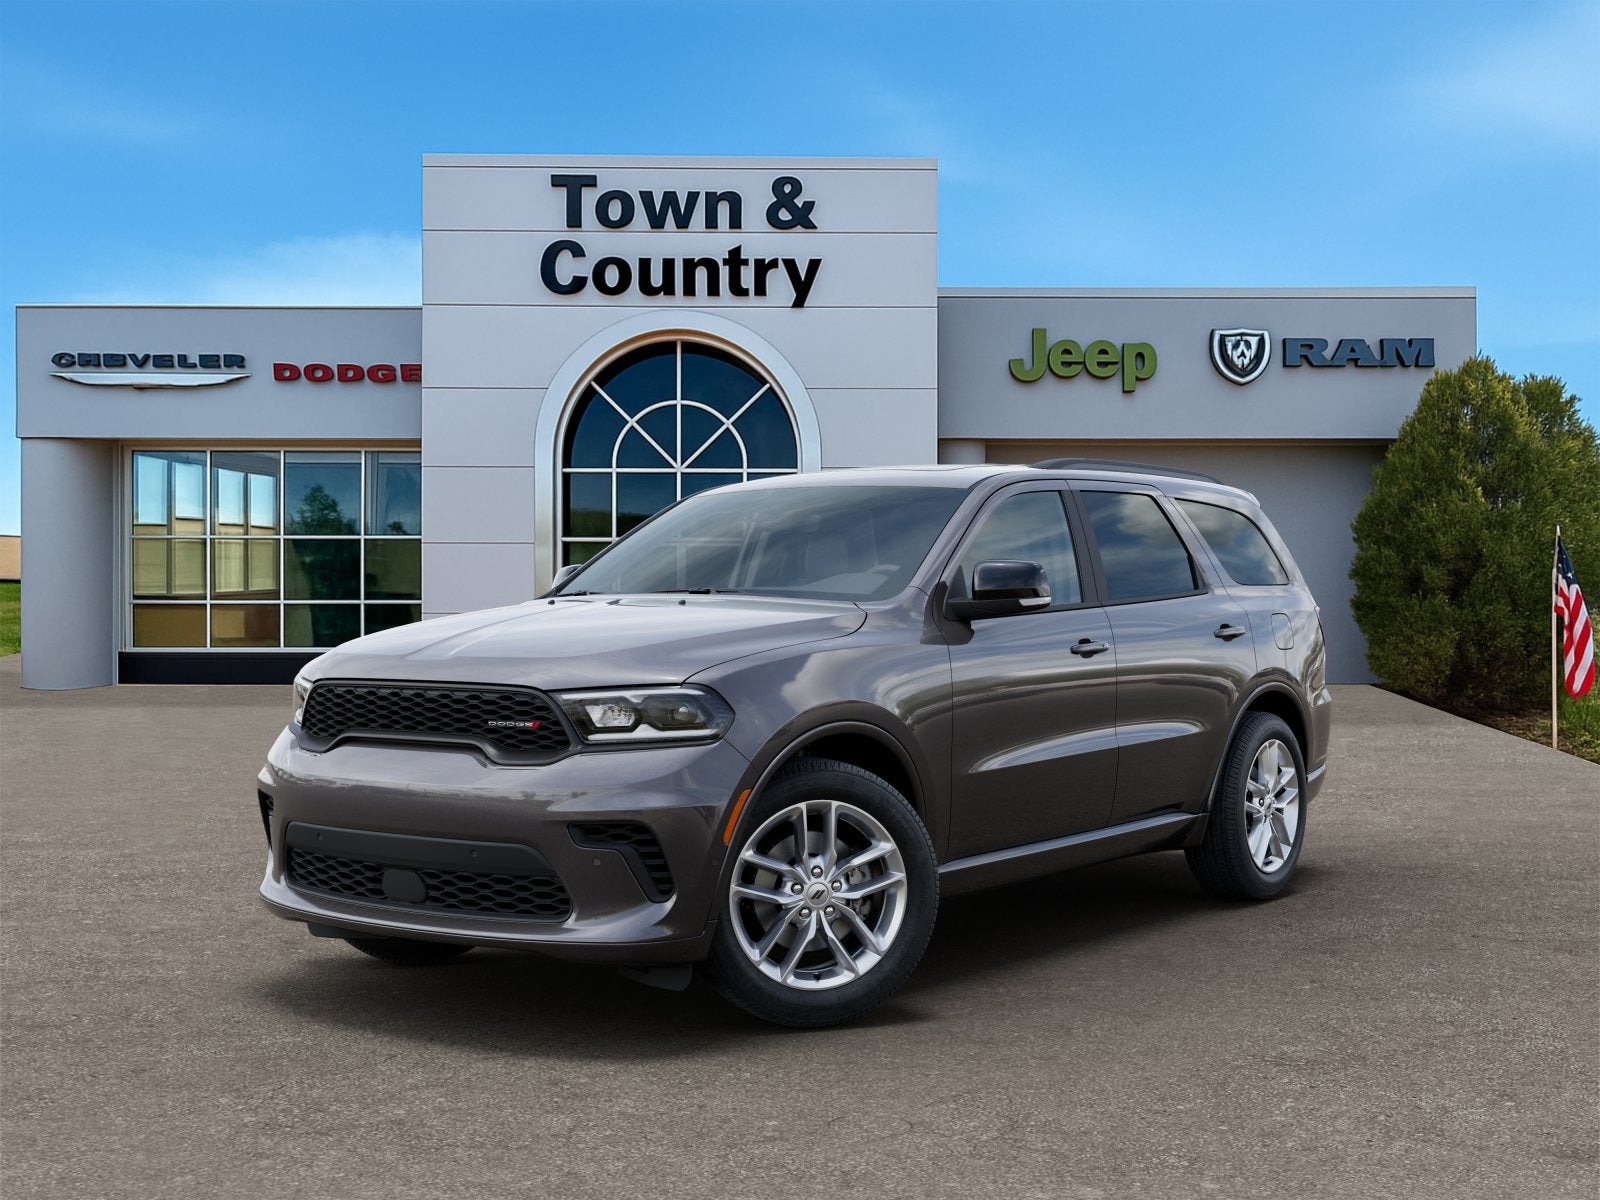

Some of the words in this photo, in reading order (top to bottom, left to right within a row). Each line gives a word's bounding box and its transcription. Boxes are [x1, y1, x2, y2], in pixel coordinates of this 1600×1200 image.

[550, 174, 742, 230] Town
[765, 175, 818, 230] &
[540, 239, 822, 308] Country
[272, 362, 422, 383] DODGE
[1009, 327, 1158, 393] Jeep
[1282, 337, 1436, 368] RAM
[487, 720, 533, 728] DODGE
